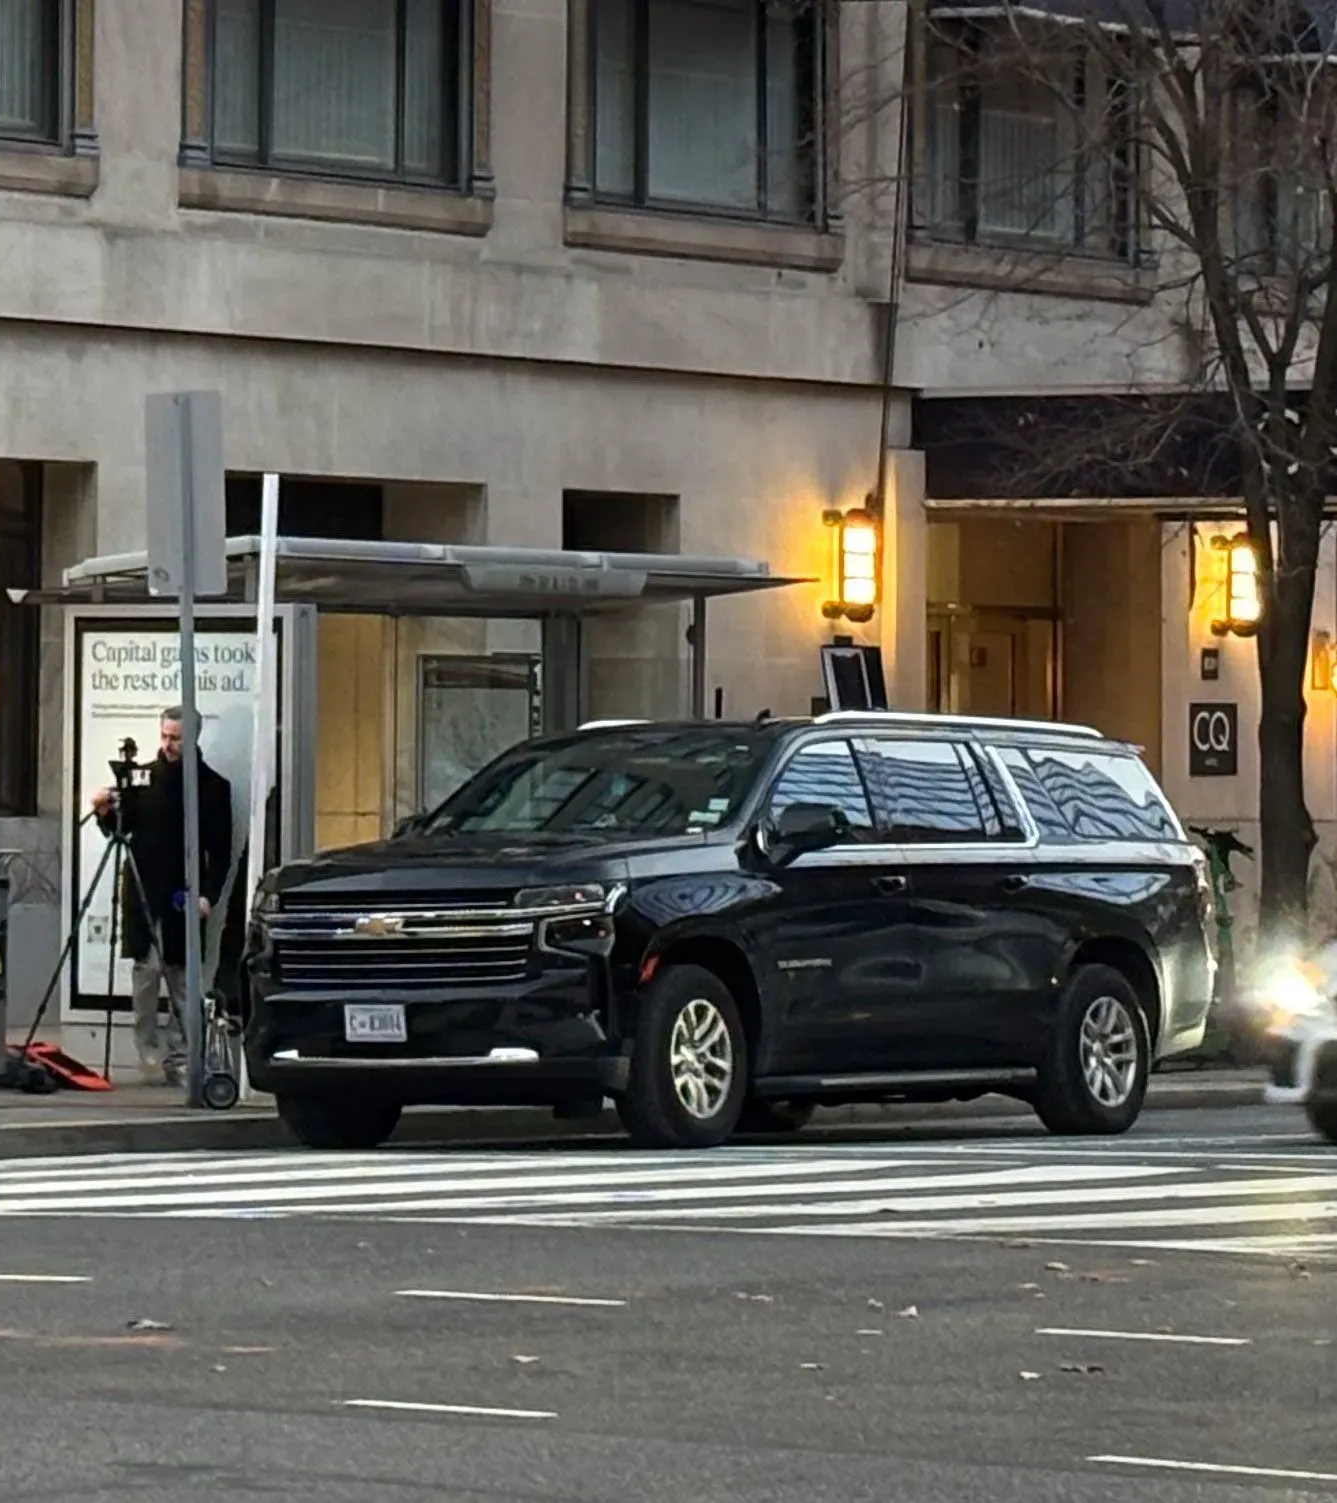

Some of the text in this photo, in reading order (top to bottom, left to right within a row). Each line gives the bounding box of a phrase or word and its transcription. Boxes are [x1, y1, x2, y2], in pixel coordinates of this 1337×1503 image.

[91, 640, 156, 667] Capital
[214, 641, 256, 663] took
[91, 668, 119, 691] the
[123, 673, 157, 691] rest
[161, 669, 180, 691] of
[221, 670, 251, 692] ad.
[1193, 711, 1230, 752] CQ
